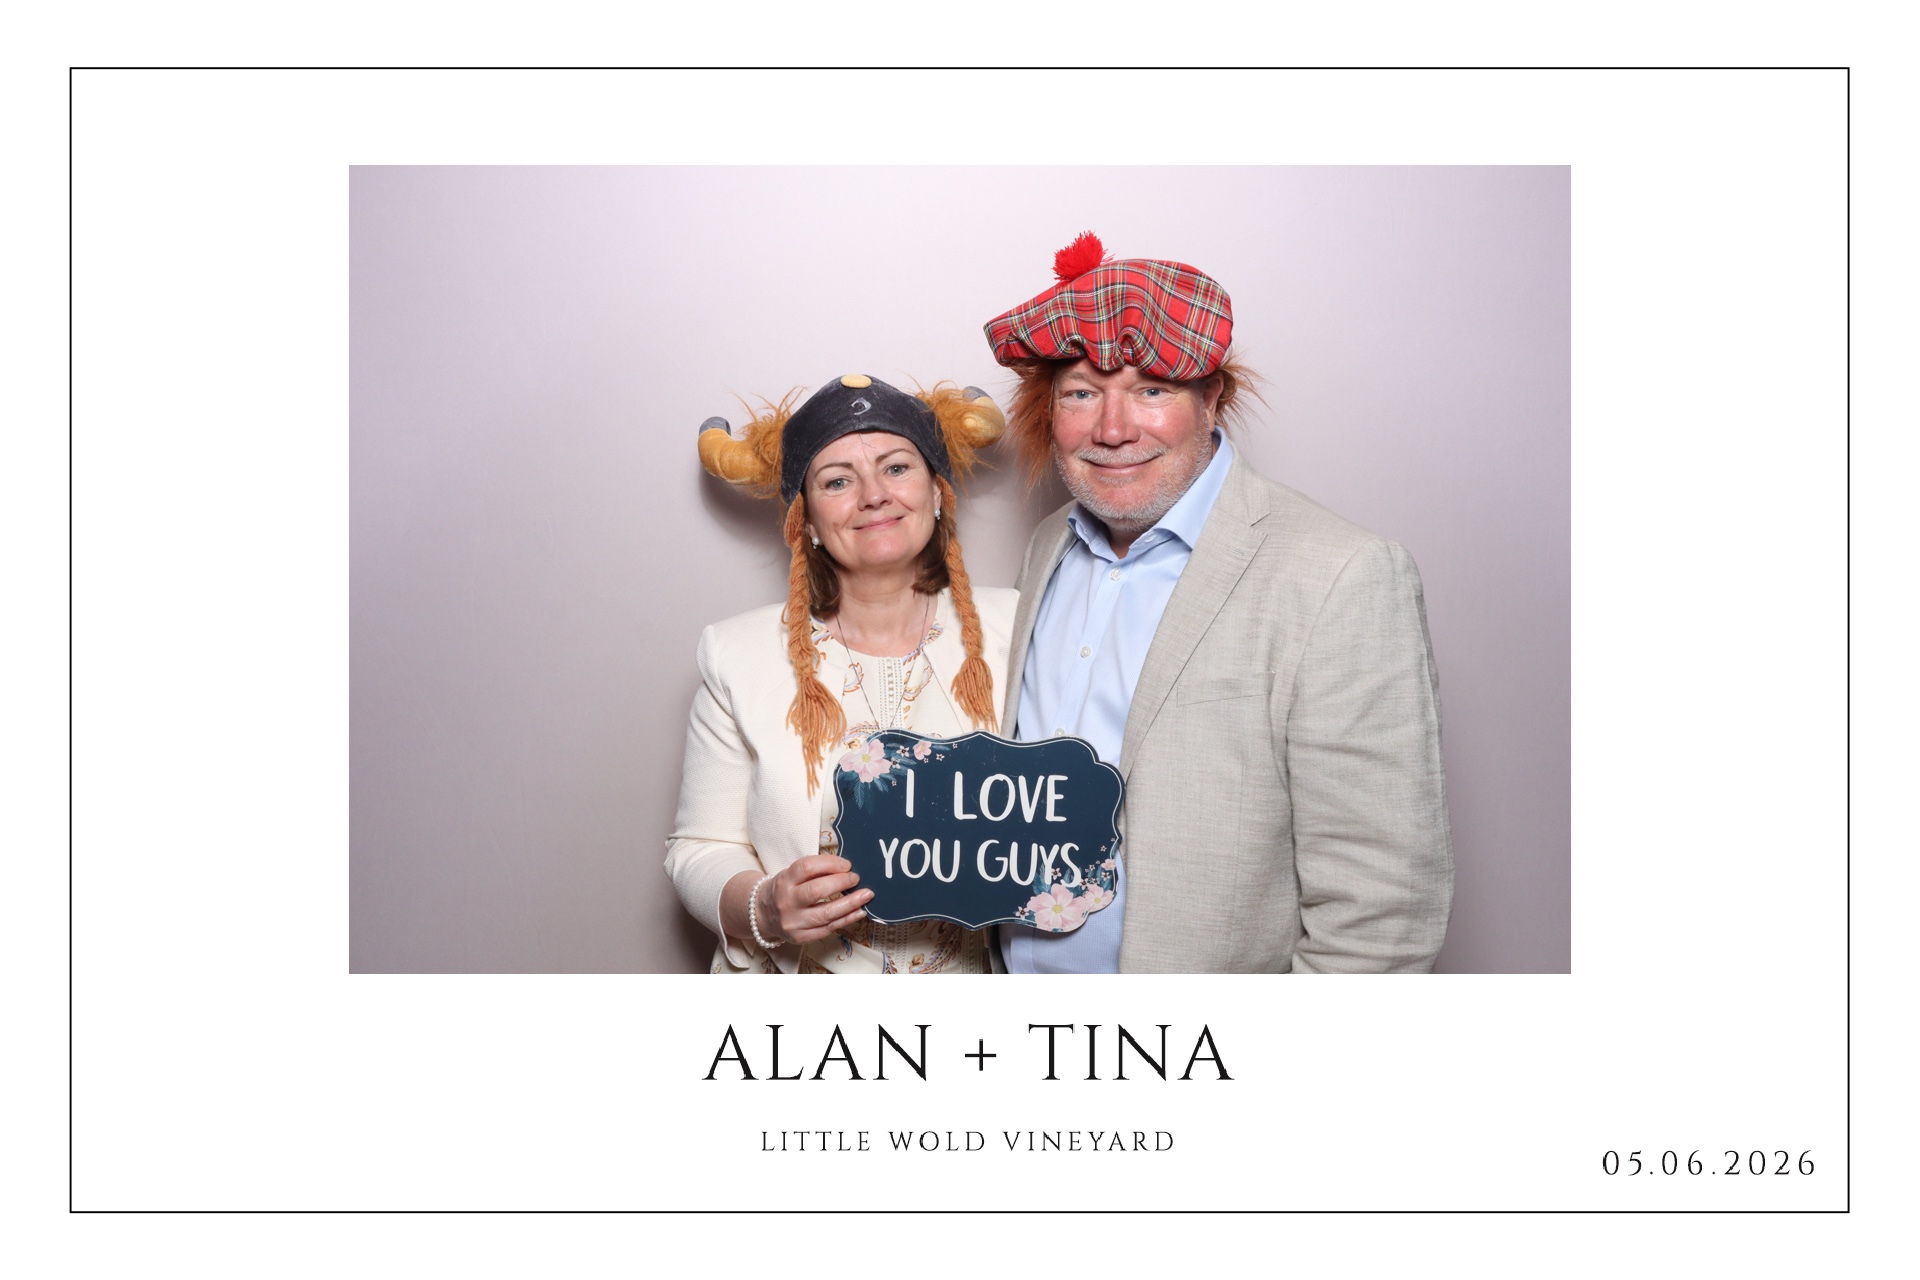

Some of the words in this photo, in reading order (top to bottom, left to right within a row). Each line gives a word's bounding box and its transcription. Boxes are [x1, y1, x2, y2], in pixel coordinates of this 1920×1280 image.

[905, 768, 915, 818] I
[953, 771, 1069, 823] LOVE
[878, 837, 961, 883] YOU
[976, 839, 1082, 888] GUYS
